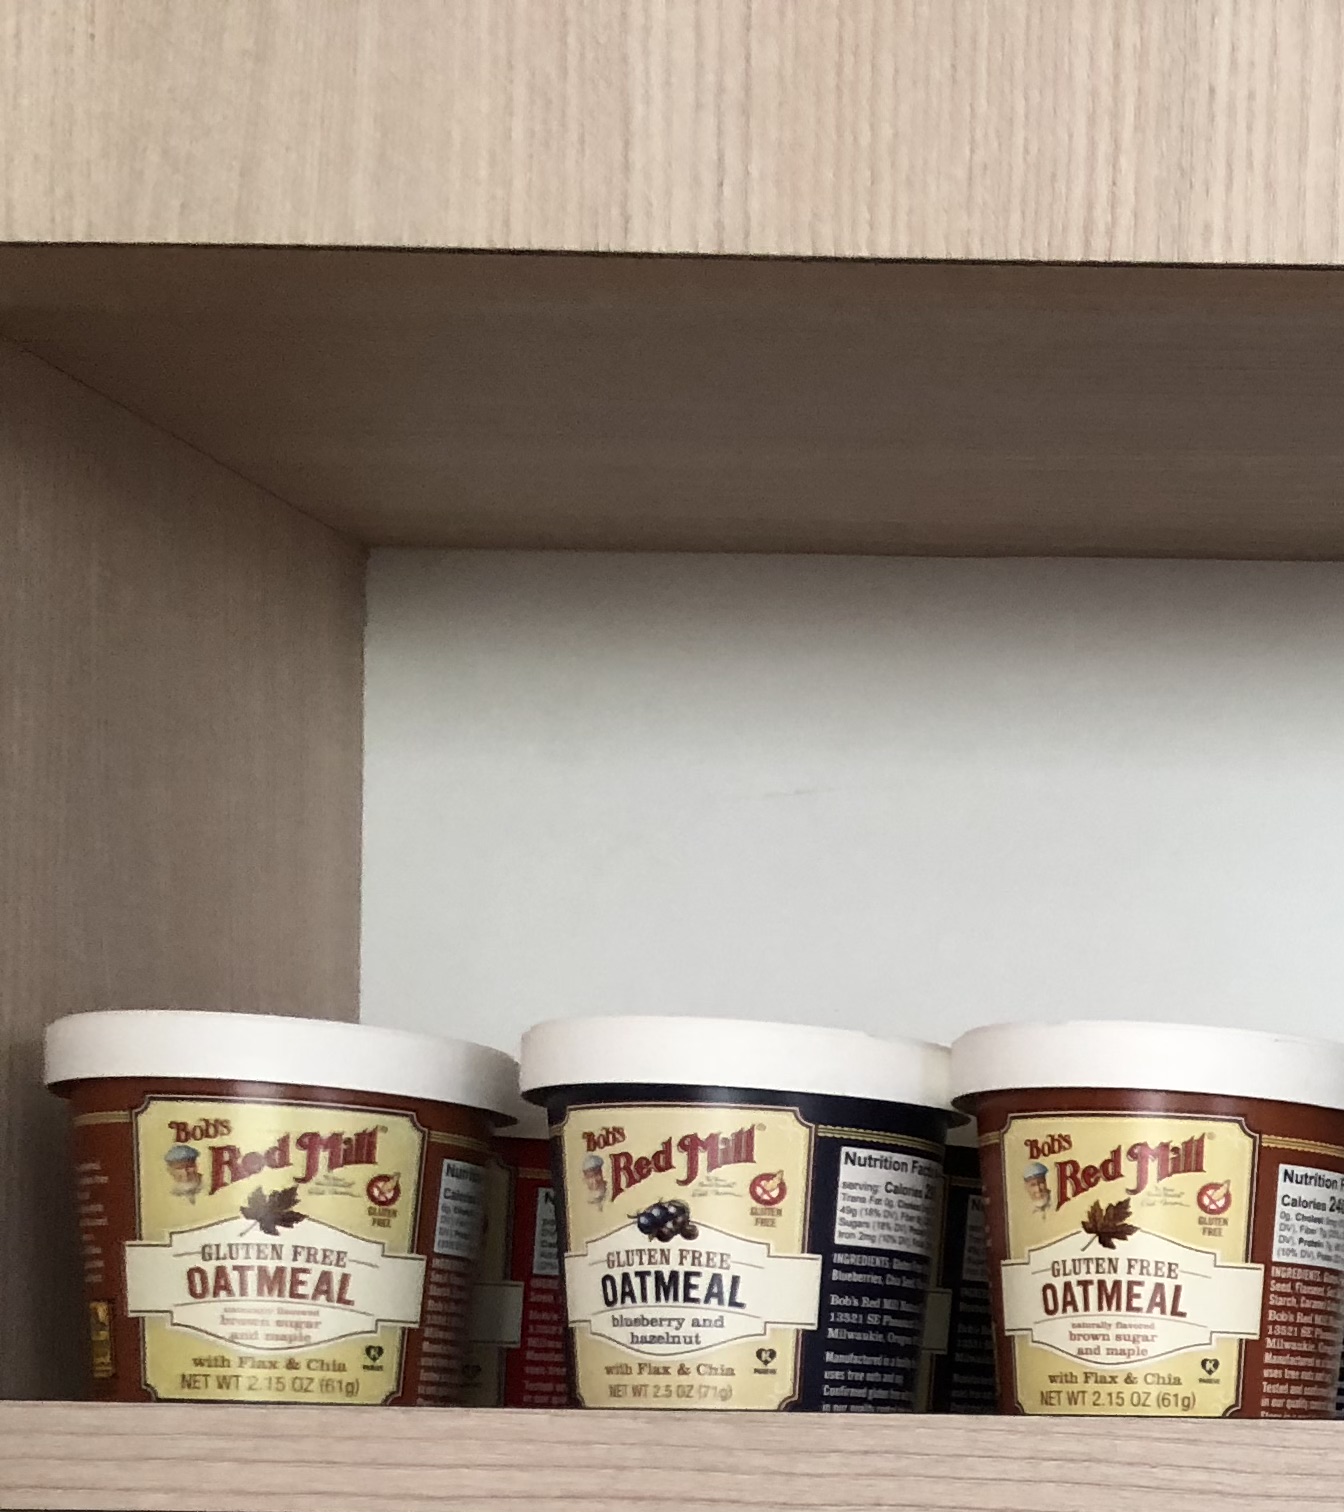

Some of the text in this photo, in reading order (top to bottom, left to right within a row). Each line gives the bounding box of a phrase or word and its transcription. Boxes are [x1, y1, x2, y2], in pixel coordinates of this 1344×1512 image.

[168, 1117, 232, 1143] Bob's
[583, 1126, 626, 1152] Bob's
[293, 1125, 379, 1184] Mill
[1024, 1134, 1073, 1160] Bob's
[609, 1124, 756, 1202] Red Mill
[844, 1151, 909, 1173] Nutrition
[1055, 1132, 1206, 1212] Red Mill
[1283, 1169, 1337, 1190] Nutrition
[1281, 1194, 1326, 1212] Calories
[1202, 1227, 1224, 1236] FREE
[201, 1243, 348, 1268] GLUTEN FREE
[606, 1248, 731, 1270] GLUTEN FREE
[1051, 1257, 1179, 1279] GLUTEN FREE
[187, 1265, 355, 1306] OATMEAL
[601, 1270, 747, 1309] OATMEAL
[1042, 1279, 1187, 1318] OATMEAL
[611, 1315, 725, 1330] blueberry and
[630, 1332, 702, 1345] hazelnut
[1069, 1331, 1158, 1344] brown sugar
[1076, 1345, 1149, 1359] and maple
[192, 1355, 231, 1368] with
[238, 1357, 279, 1370] Flax
[285, 1358, 300, 1371] &
[306, 1358, 347, 1372] Chia
[605, 1363, 736, 1376] with Flax & Chia
[180, 1373, 359, 1396] NET WT 2.15 OZ (61g)
[1048, 1371, 1182, 1386] with Flax & Chia
[608, 1384, 628, 1398] NET
[631, 1384, 650, 1398] WT
[653, 1385, 672, 1398] 2.5
[676, 1385, 694, 1398] OZ
[1040, 1391, 1197, 1411] NET WT 2.15 OZ (61g)
